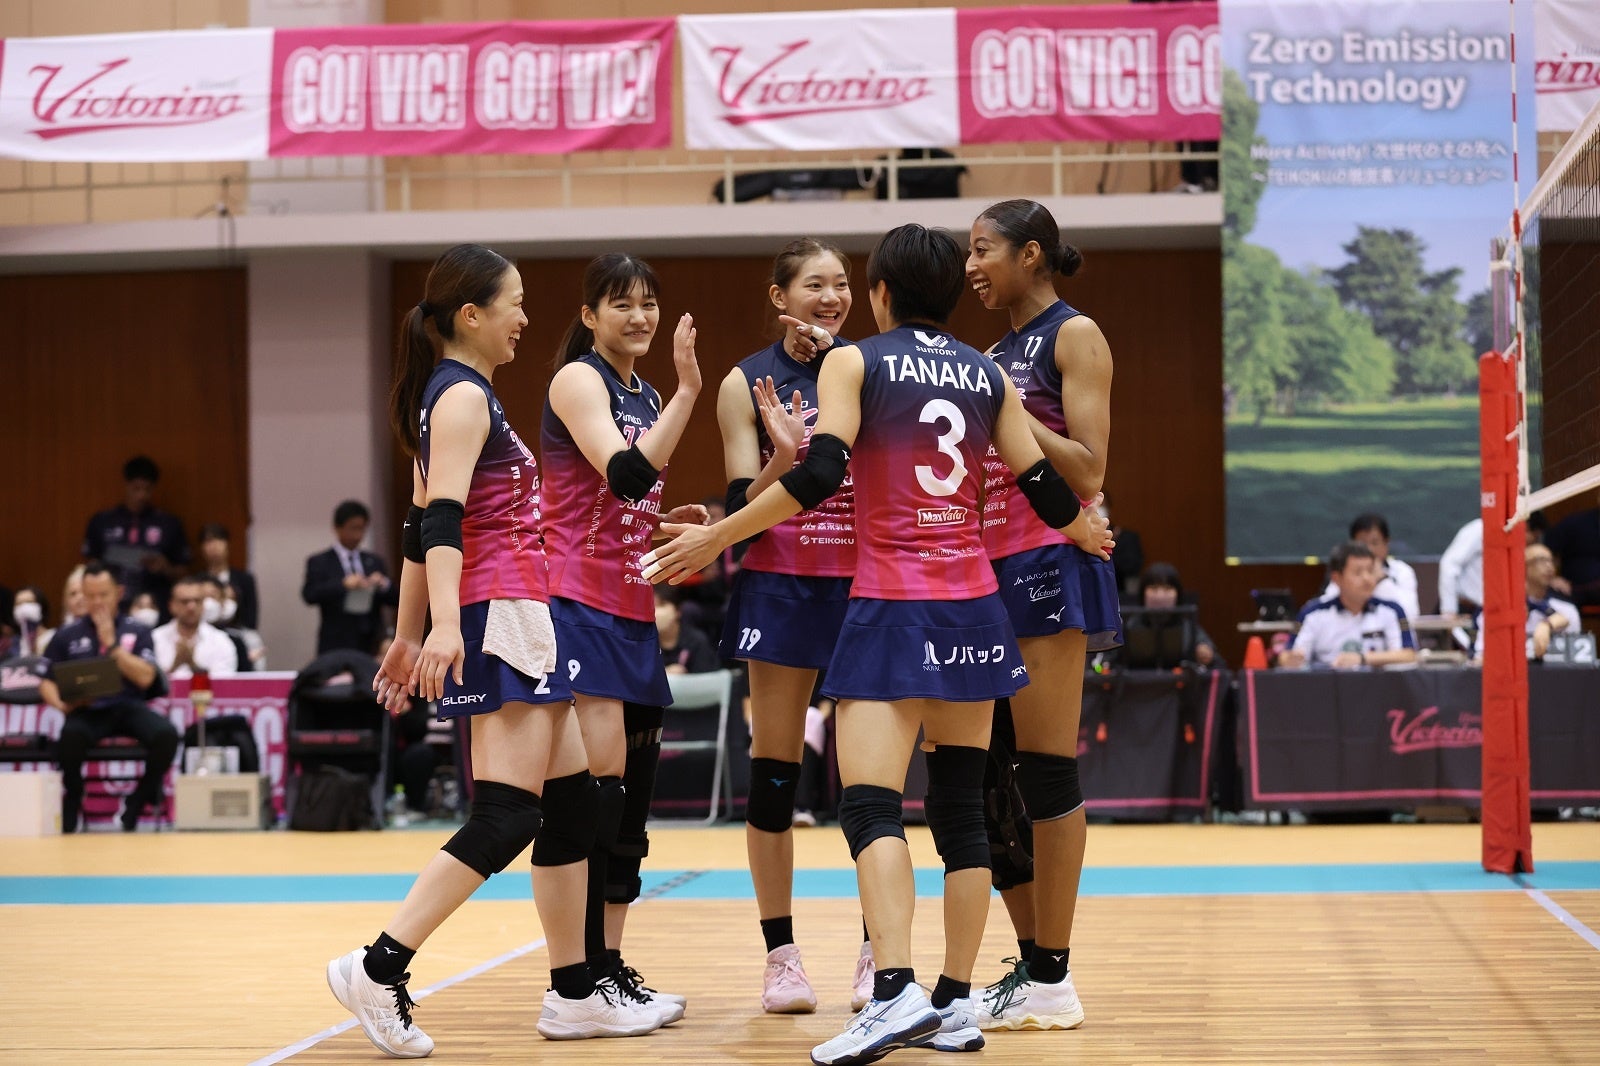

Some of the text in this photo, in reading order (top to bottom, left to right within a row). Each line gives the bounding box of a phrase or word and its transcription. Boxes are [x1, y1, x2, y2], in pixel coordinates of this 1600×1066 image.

[1249, 30, 1506, 63] Zero Emission
[290, 47, 652, 126] GO! VIC! GO! VIC!
[710, 39, 934, 125] Victorina
[979, 32, 1221, 111] GO! VIC! GO
[28, 58, 245, 139] Victorina
[1248, 69, 1466, 110] Technology
[914, 345, 957, 357] SUNTORY
[1024, 335, 1044, 358] 11
[883, 354, 993, 396] TANAKA
[914, 398, 968, 498] 3
[810, 537, 855, 545] TEIKOKU
[738, 627, 762, 652] 19
[943, 644, 1005, 665] ノバック
[1574, 637, 1593, 664] 2
[442, 693, 488, 706] GLORY
